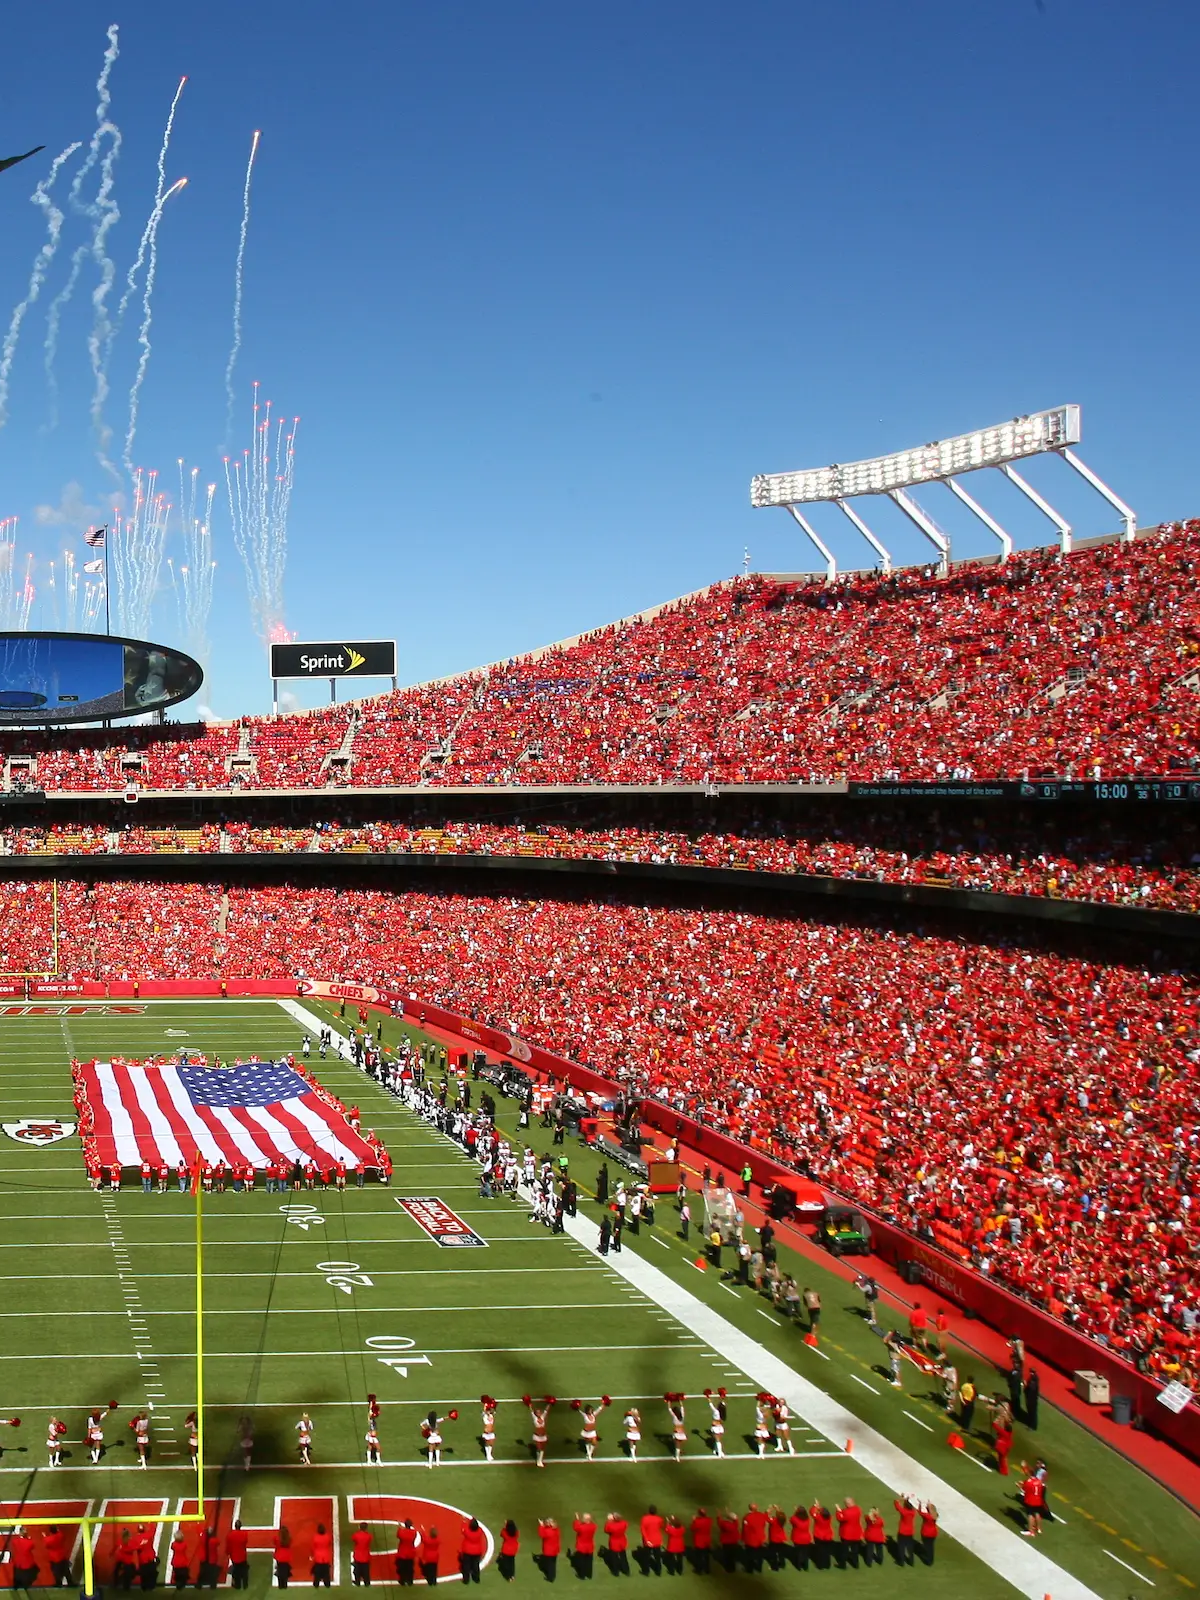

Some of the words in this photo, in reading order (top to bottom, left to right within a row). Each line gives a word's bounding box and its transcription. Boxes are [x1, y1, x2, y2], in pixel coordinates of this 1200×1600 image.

[300, 654, 344, 672] Sprint
[1044, 786, 1050, 796] 0
[1094, 784, 1128, 799] 15:00
[1138, 791, 1148, 799] 35
[1174, 786, 1180, 797] 0
[329, 984, 364, 998] CHIEFS
[279, 1204, 325, 1225] 30
[406, 1202, 443, 1233] FOOTBALL
[421, 1202, 452, 1220] BACK
[442, 1221, 464, 1232] TO
[316, 1262, 374, 1287] 20
[914, 1261, 966, 1301] OOTBALL
[365, 1336, 433, 1367] 10
